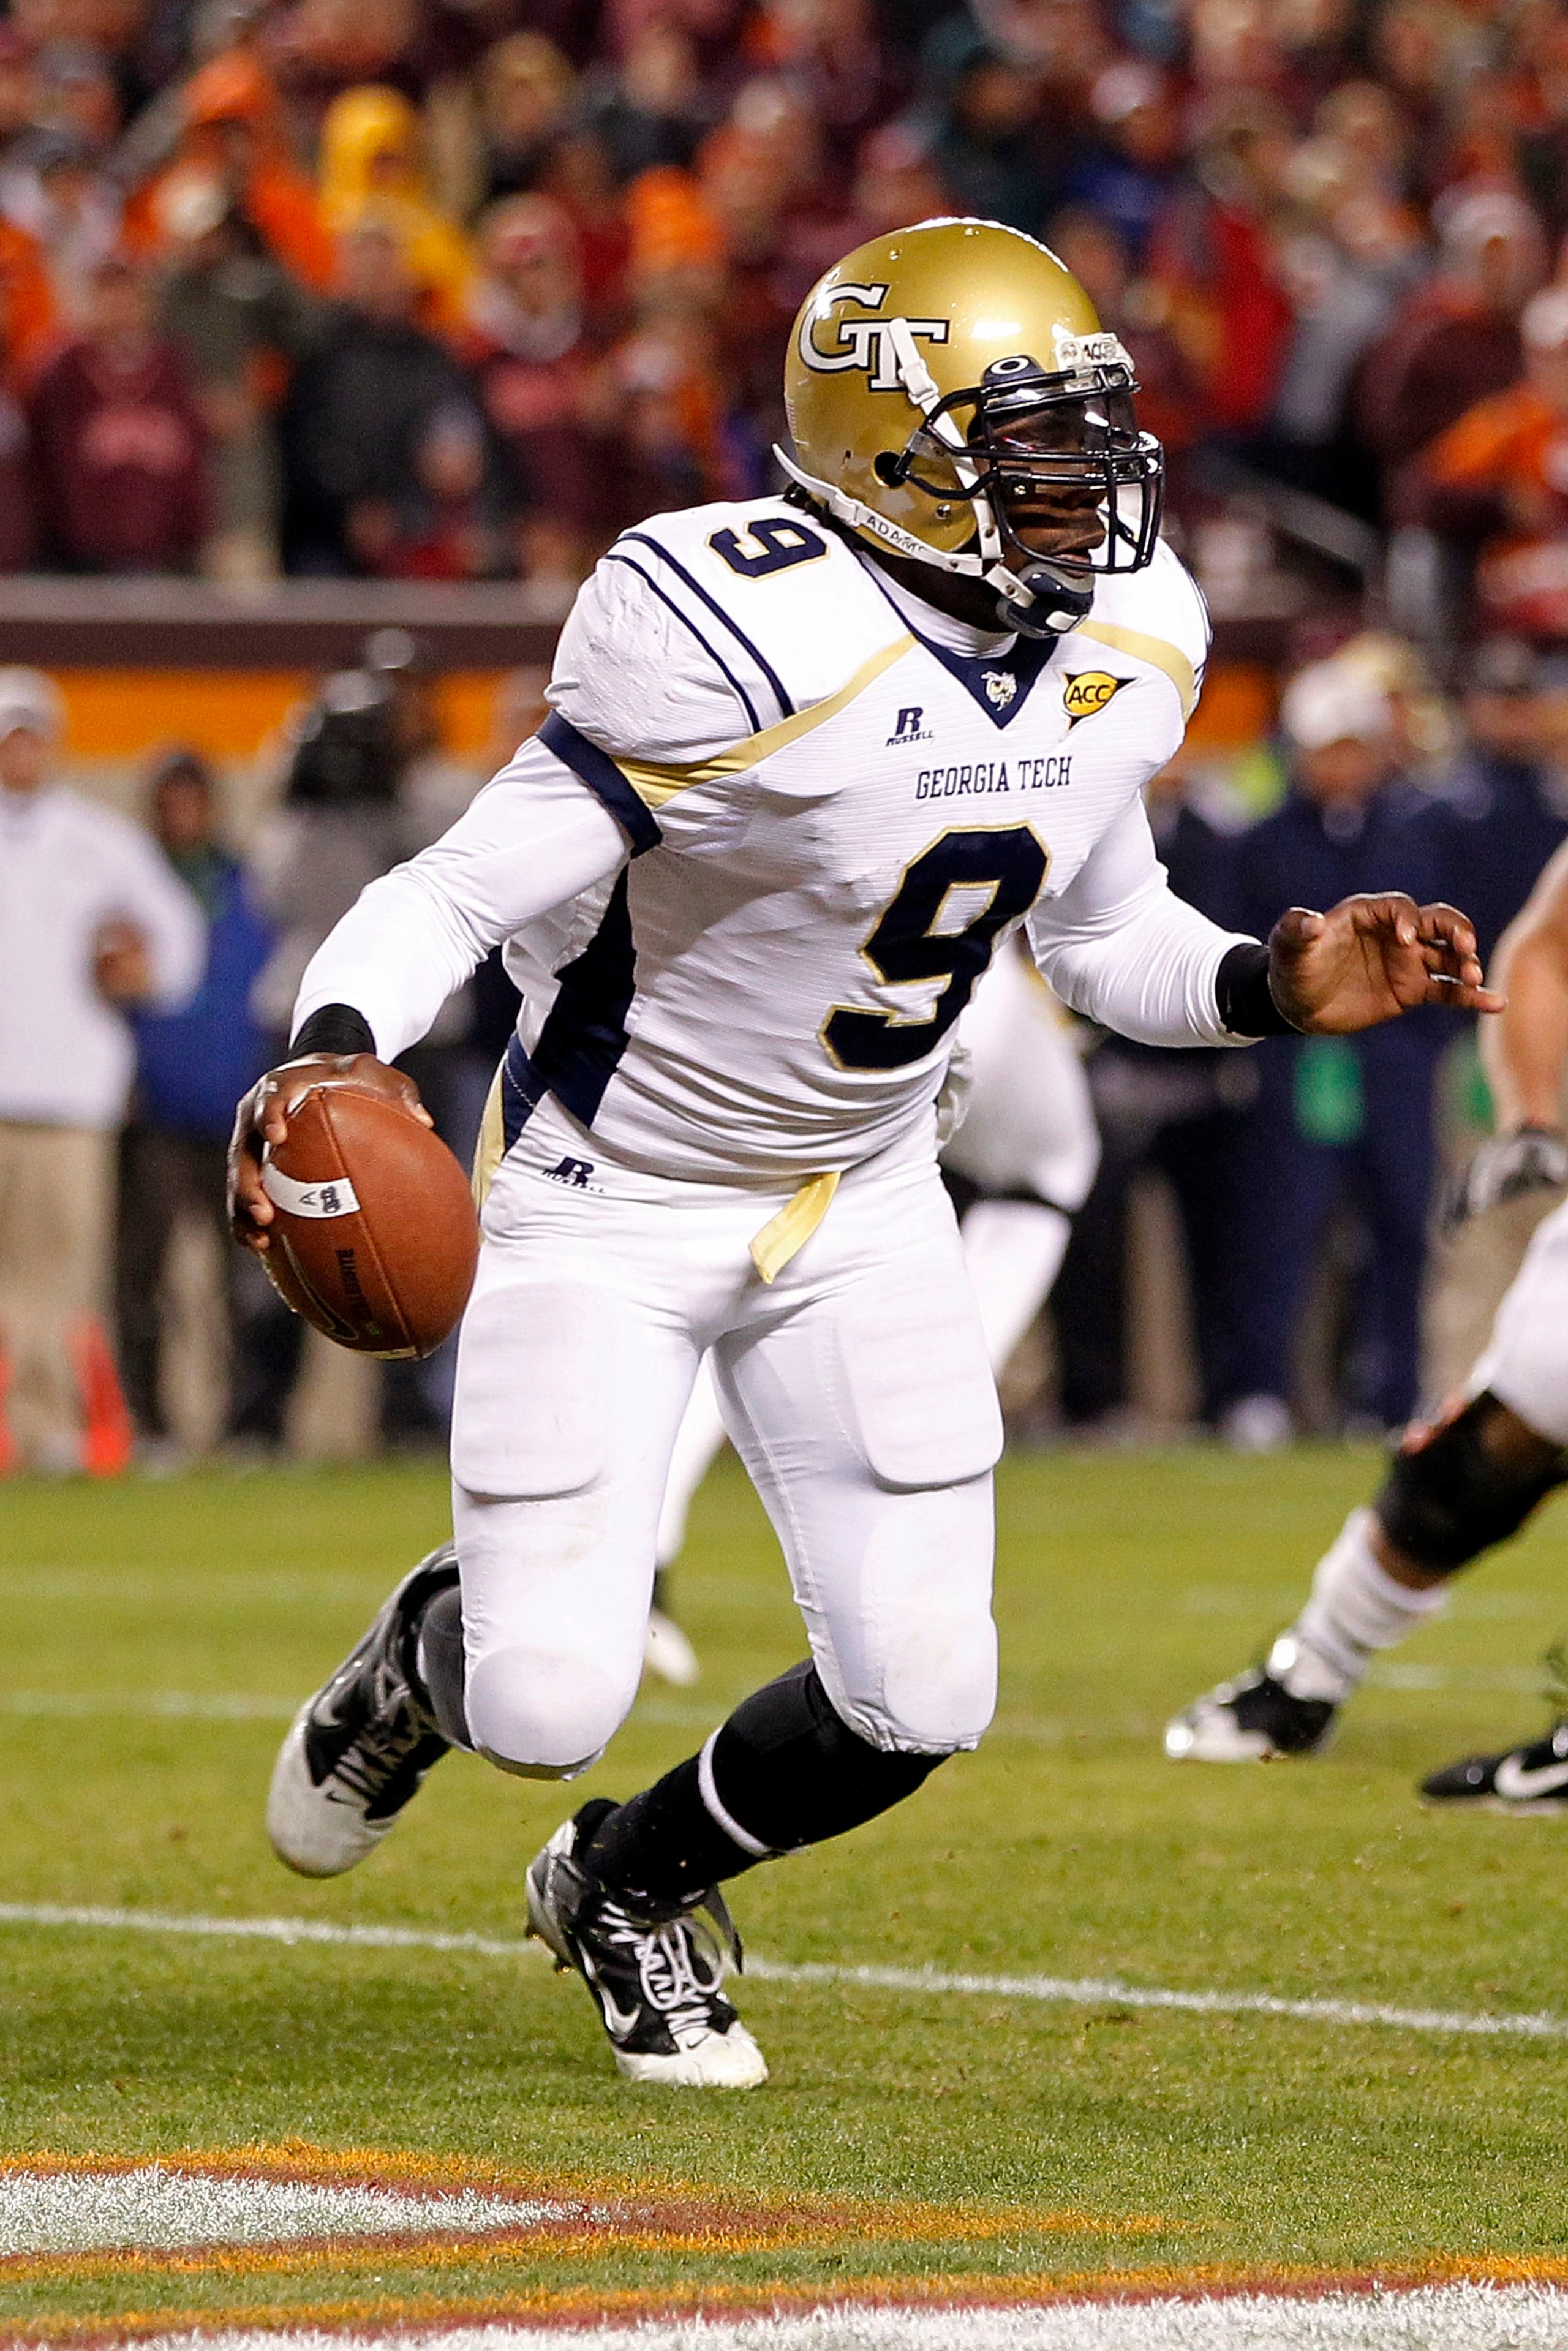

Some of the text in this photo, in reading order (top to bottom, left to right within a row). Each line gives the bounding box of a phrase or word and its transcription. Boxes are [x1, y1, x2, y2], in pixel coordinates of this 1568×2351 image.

[799, 283, 950, 392] GT
[705, 518, 829, 582] 9
[1068, 685, 1110, 704] ACC
[895, 706, 924, 736] R
[916, 756, 1072, 799] GEORGIA TECH
[818, 820, 1051, 1073] 9
[554, 1155, 594, 1187] R
